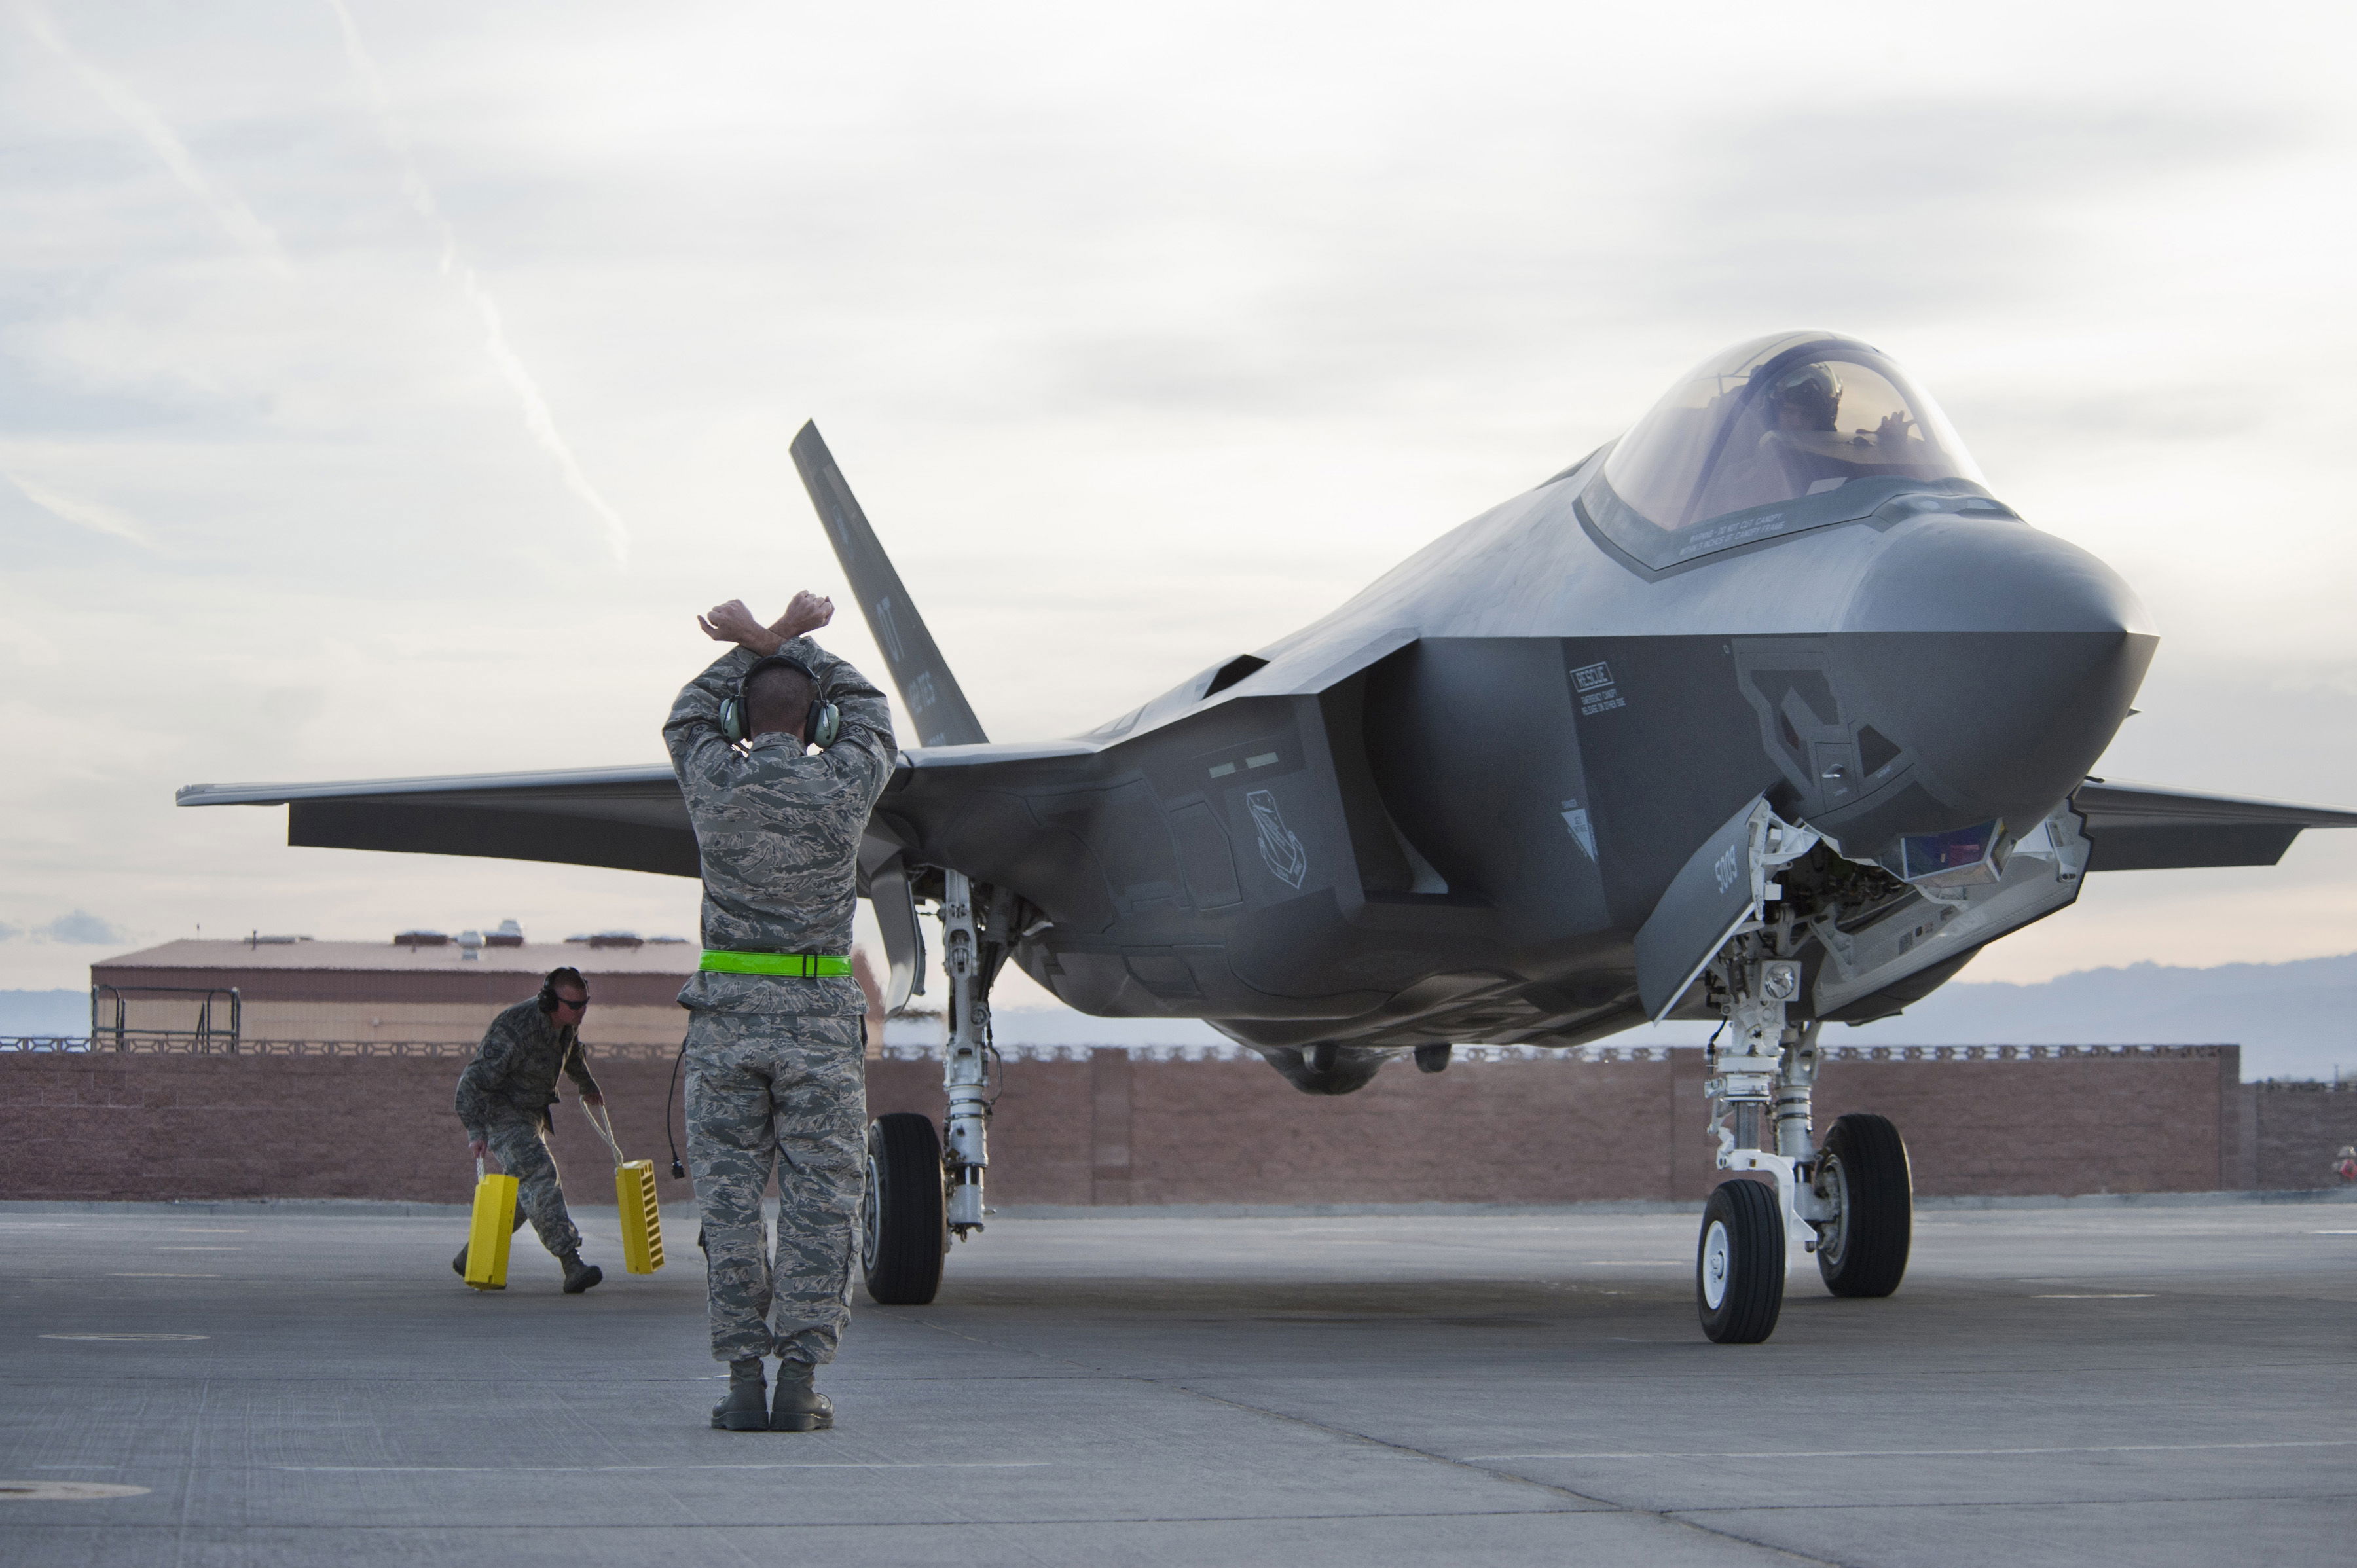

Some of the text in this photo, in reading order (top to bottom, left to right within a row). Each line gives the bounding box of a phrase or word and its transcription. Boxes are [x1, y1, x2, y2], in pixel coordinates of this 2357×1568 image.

[1717, 526, 1727, 536] DO
[1727, 523, 1740, 533] NOT
[1740, 519, 1754, 529] CUT
[1755, 513, 1783, 526] CANOPY
[1734, 526, 1761, 539] CANOPY
[1761, 521, 1786, 534] FRAME
[876, 596, 905, 663] OT
[1576, 666, 1607, 687] RESCUE
[1715, 845, 1738, 894] 5009
